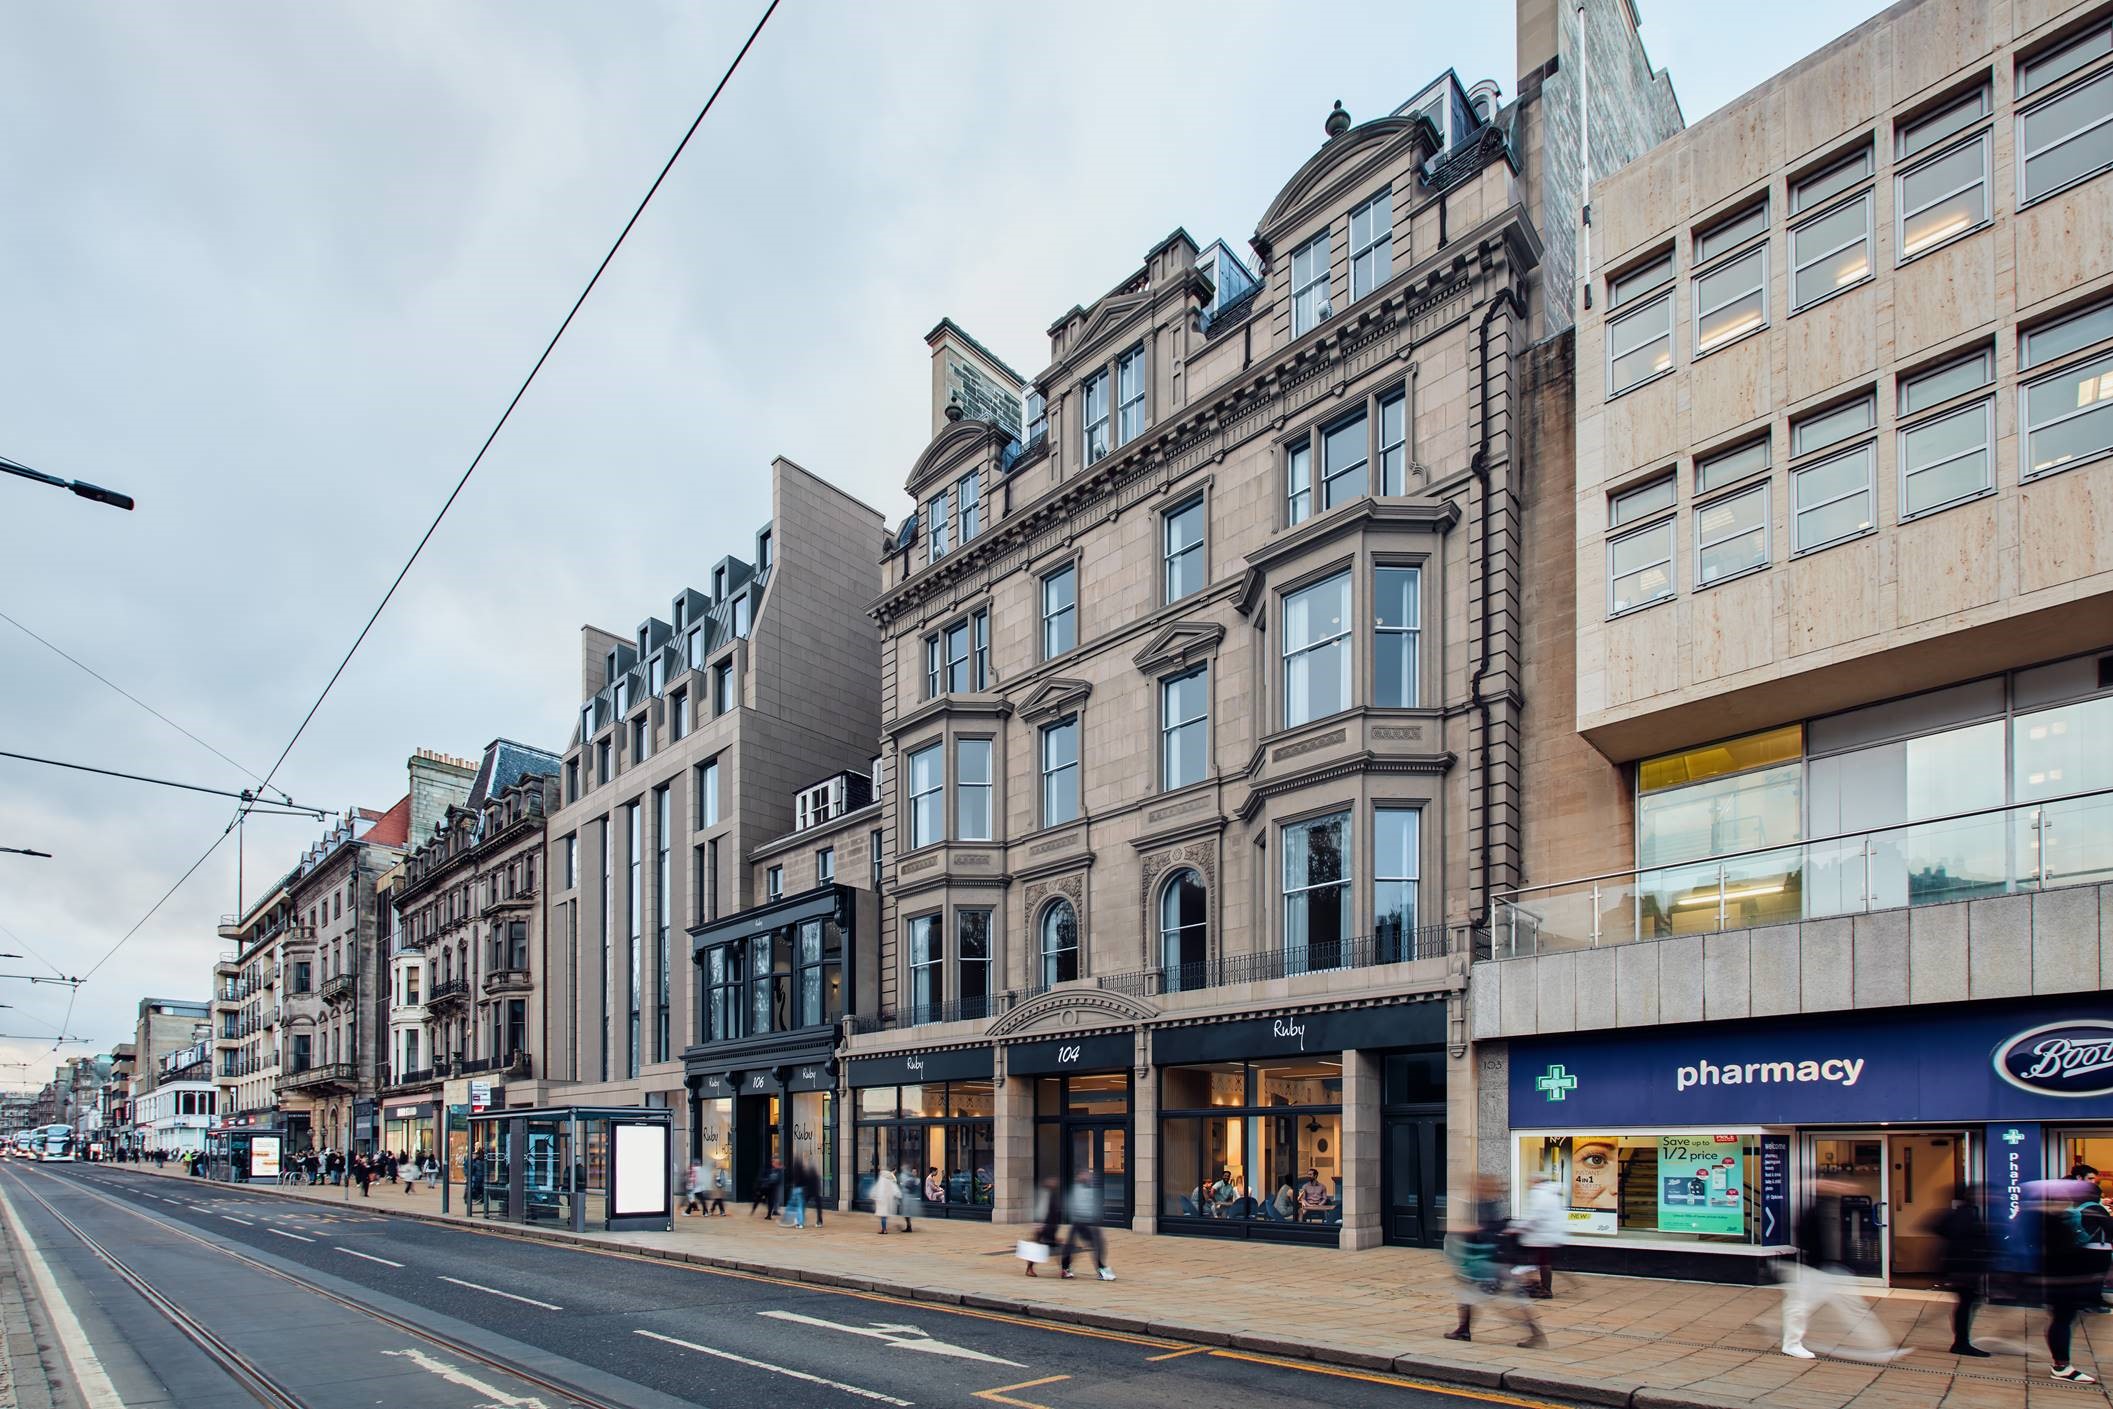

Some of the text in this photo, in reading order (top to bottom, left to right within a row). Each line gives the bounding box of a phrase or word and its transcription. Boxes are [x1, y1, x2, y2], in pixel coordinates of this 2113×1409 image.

[1273, 1016, 1305, 1051] Ruby
[1058, 1045, 1080, 1063] 104
[907, 1055, 924, 1080] Ruby
[1483, 1061, 1502, 1070] 103
[1677, 1058, 1864, 1092] pharmacy
[709, 1077, 720, 1096] Ruby
[752, 1076, 765, 1089] 106
[802, 1066, 817, 1088] Ruby
[703, 1126, 719, 1155] Ruby
[793, 1122, 813, 1155] Ruby
[1663, 1136, 1690, 1146] Save
[1663, 1147, 1687, 1160] 1/2
[1690, 1151, 1718, 1162] price
[2007, 1152, 2021, 1220] pharmacy
